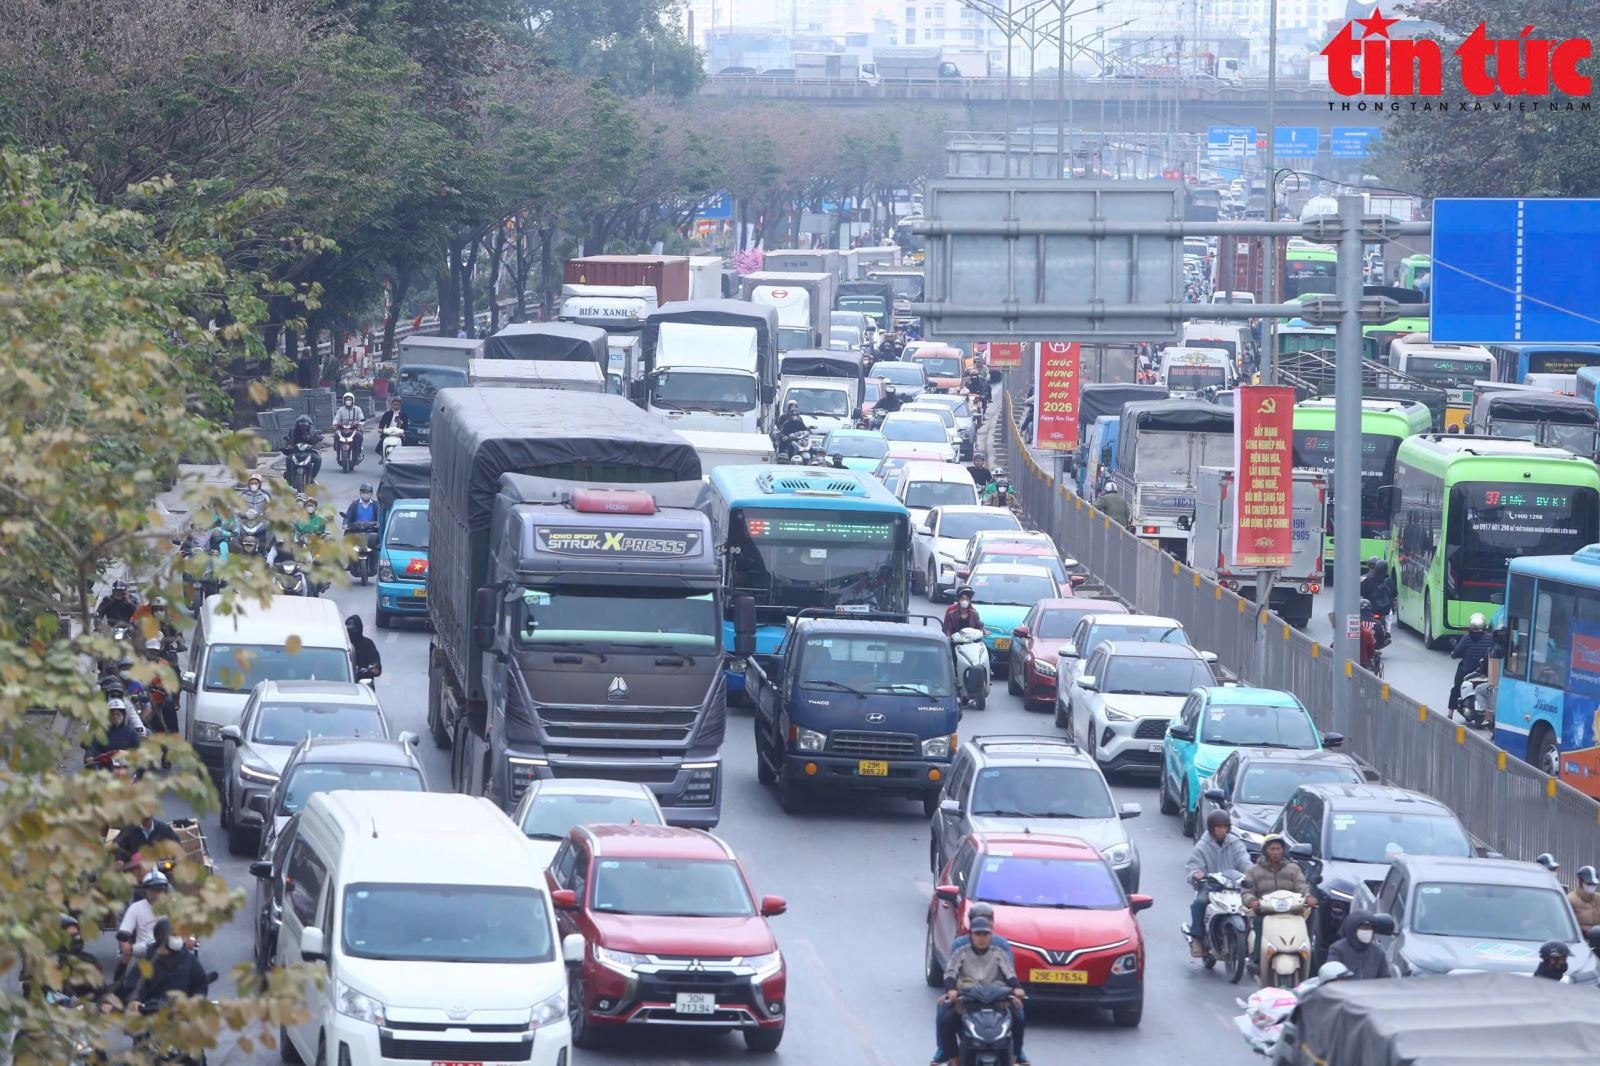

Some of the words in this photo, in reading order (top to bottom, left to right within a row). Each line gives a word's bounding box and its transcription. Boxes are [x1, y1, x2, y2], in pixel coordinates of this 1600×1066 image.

[603, 308, 628, 316] XANH
[1046, 358, 1072, 366] CHÚC
[1045, 368, 1074, 377] MỪNG
[1048, 380, 1070, 388] NĂM
[1044, 402, 1072, 412] 2026
[1486, 490, 1500, 504] 37
[1293, 519, 1305, 528] 19H
[548, 540, 600, 549] SITRUK
[688, 995, 704, 1003] 30H
